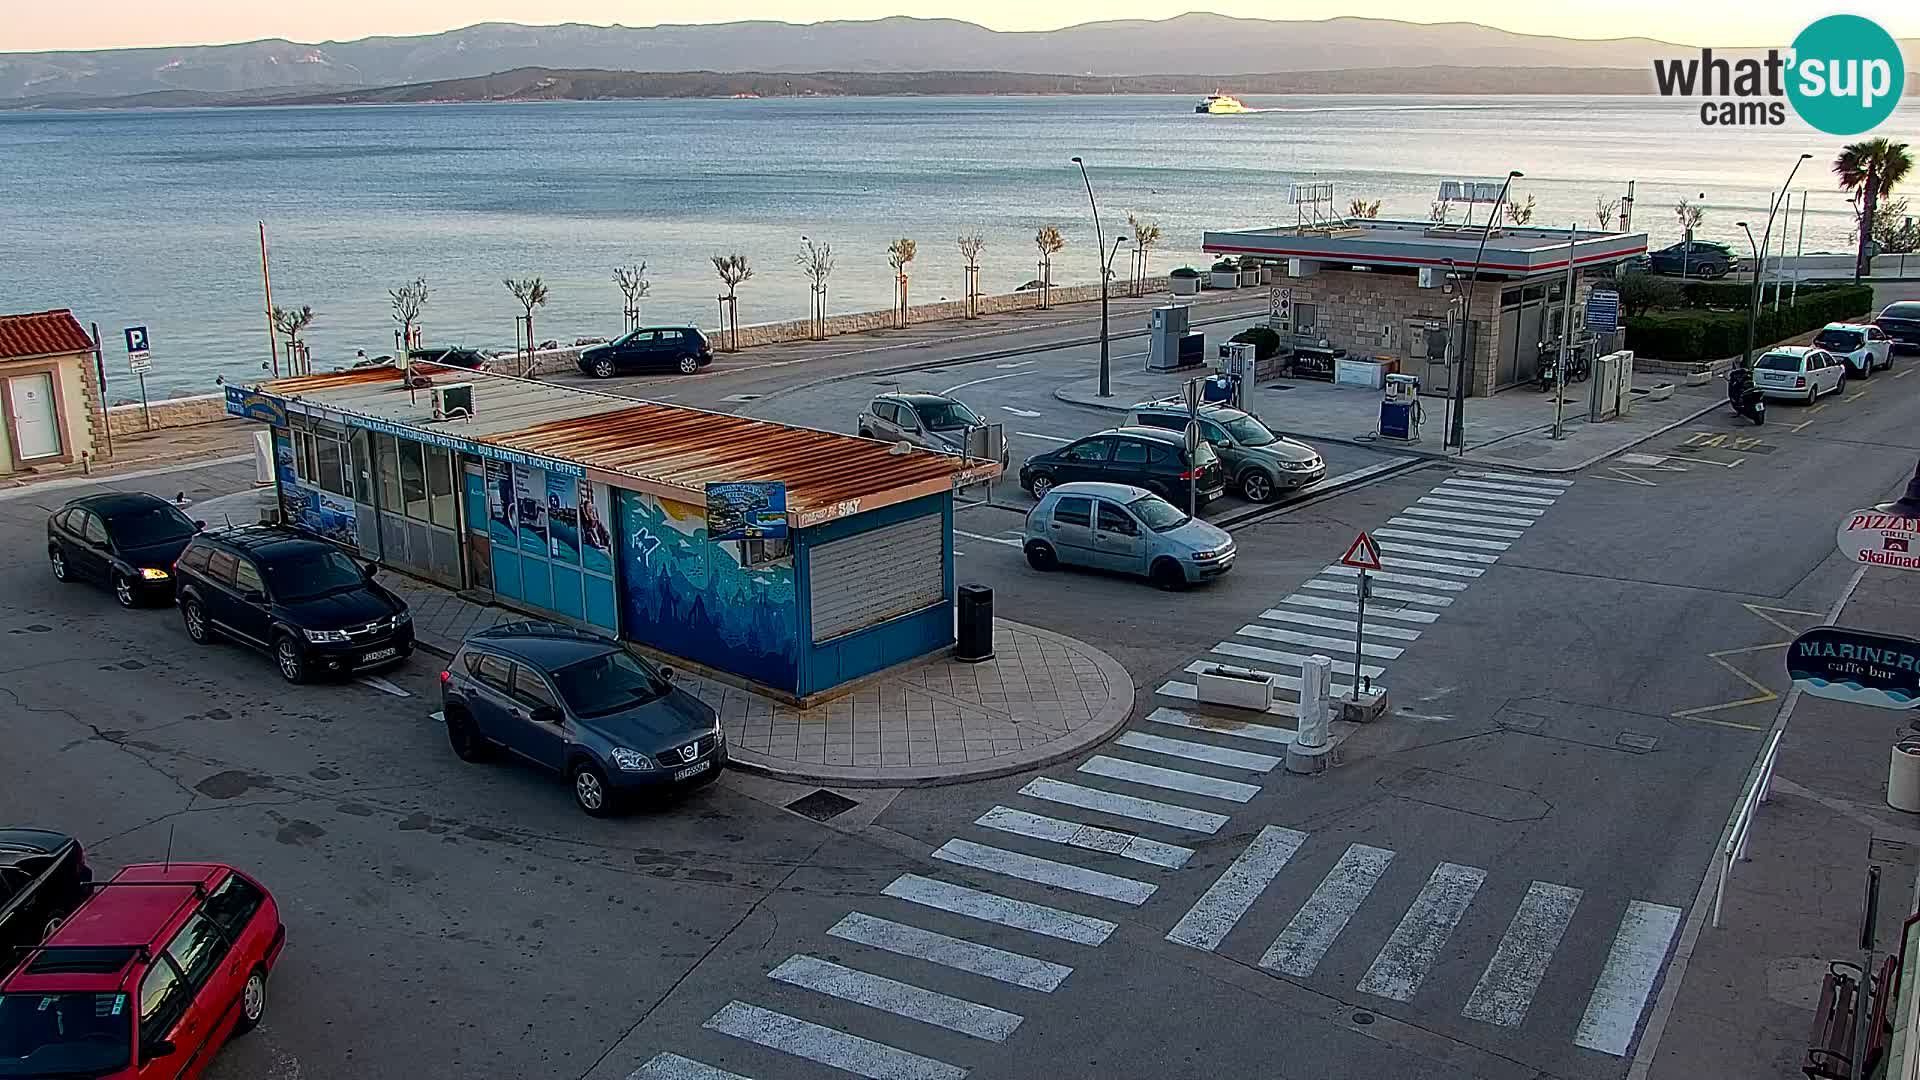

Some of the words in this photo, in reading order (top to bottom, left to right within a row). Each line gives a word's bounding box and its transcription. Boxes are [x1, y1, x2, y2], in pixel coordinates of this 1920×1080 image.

[130, 330, 143, 349] P
[1683, 431, 1763, 451] TAXI
[477, 444, 493, 457] BUS
[494, 448, 526, 465] STATION
[527, 456, 555, 471] TICKET
[555, 462, 583, 477] OFFICE
[1880, 530, 1915, 541] GRILL
[1828, 661, 1865, 676] caffe
[1869, 665, 1896, 680] bar
